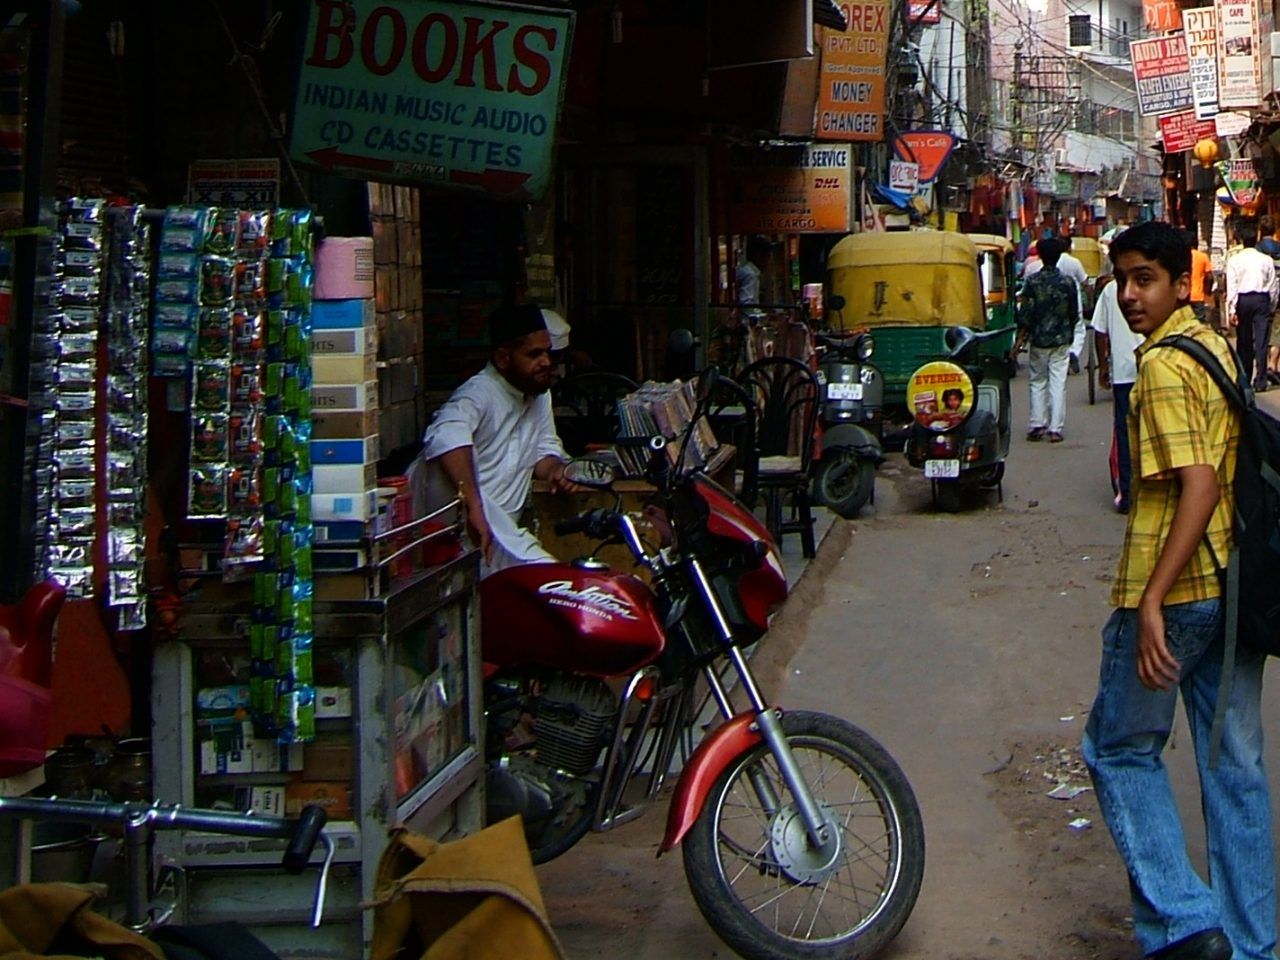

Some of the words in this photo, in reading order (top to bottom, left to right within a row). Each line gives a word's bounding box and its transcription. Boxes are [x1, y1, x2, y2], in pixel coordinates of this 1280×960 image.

[846, 3, 885, 33] OREX
[1135, 41, 1161, 62] AUDI
[1166, 38, 1187, 57] JEA
[832, 82, 873, 103] MONEY
[303, 83, 387, 115] INDIAN
[395, 95, 466, 126] MUSIC
[472, 106, 547, 136] AUDIO
[822, 112, 879, 134] CHANGER
[320, 120, 354, 144] CD
[365, 126, 523, 168] CASSETTES
[812, 151, 847, 167] SERVICE
[815, 178, 839, 188] DHL
[915, 373, 963, 385] EVEREST
[549, 597, 577, 611] HERO
[576, 602, 613, 622] HONDA
